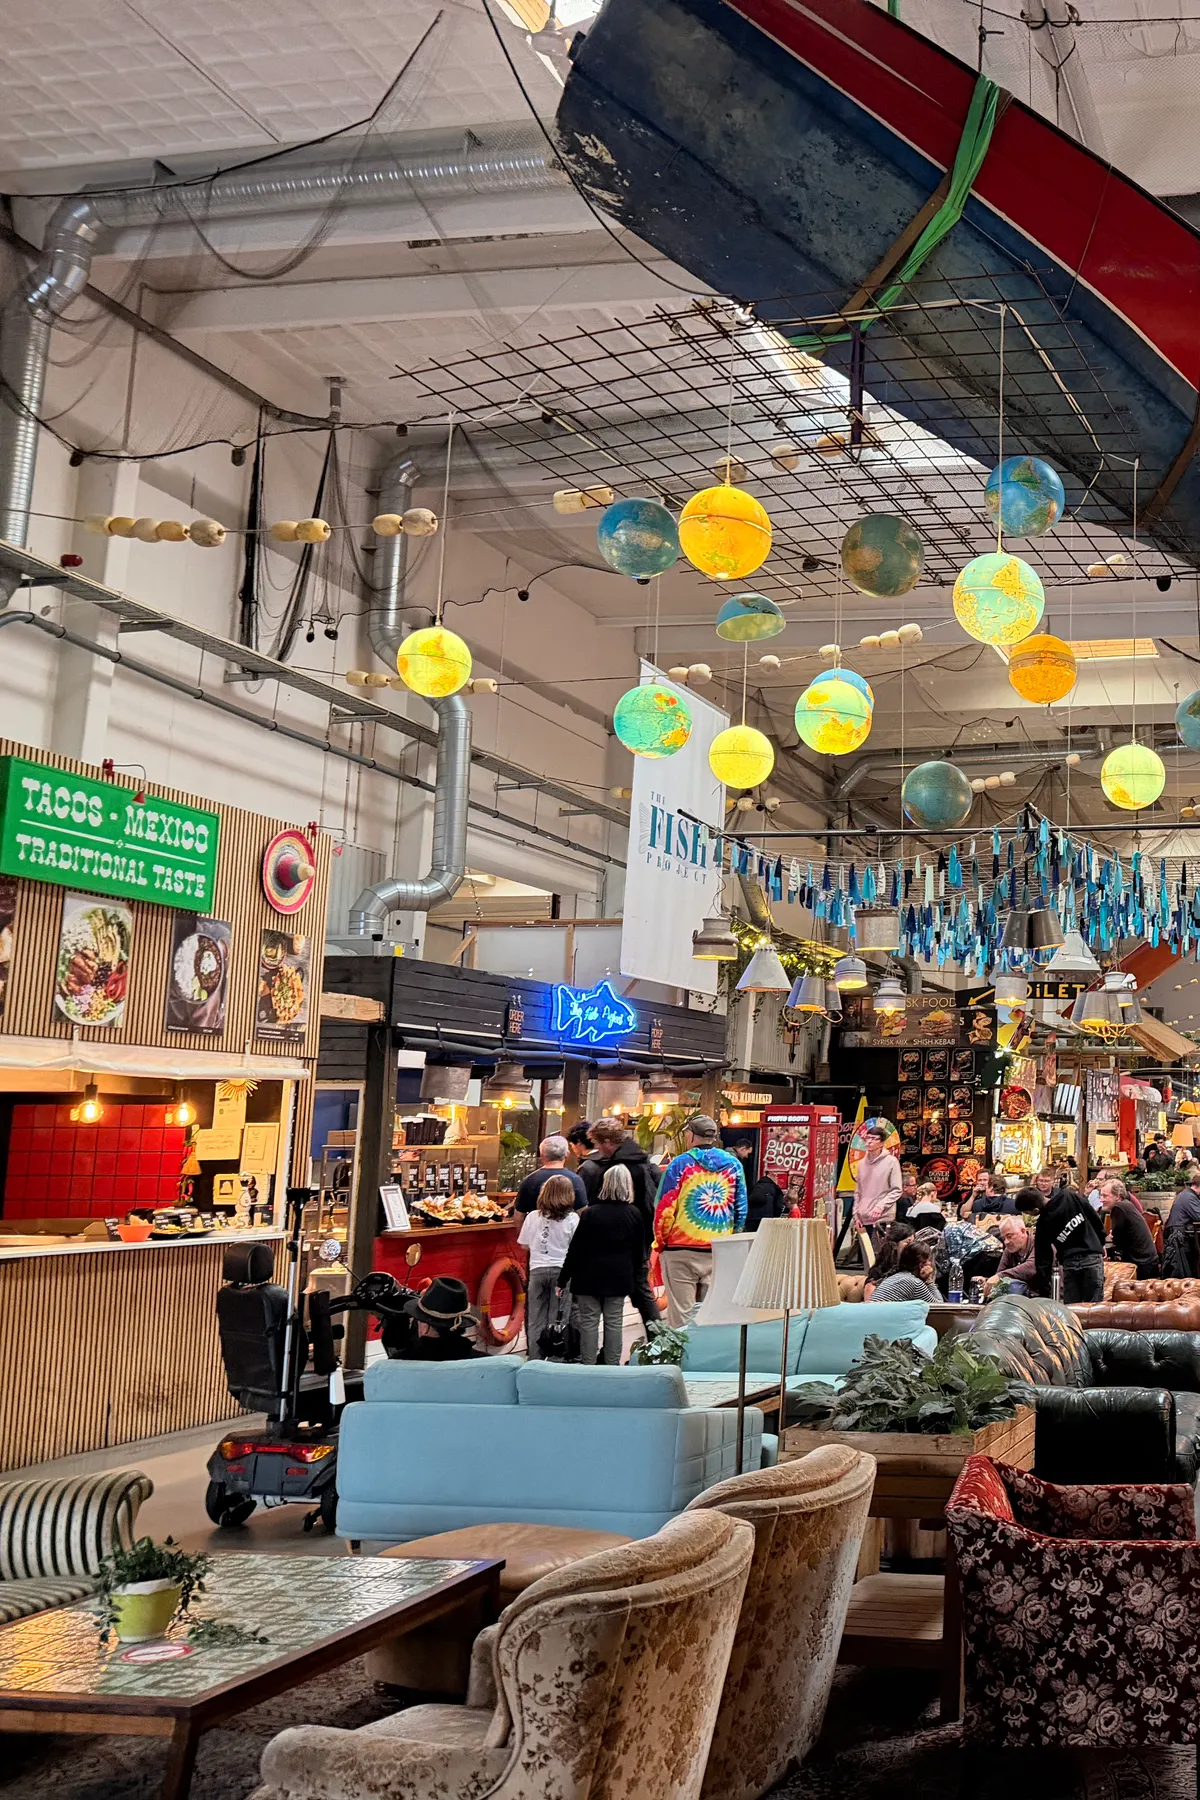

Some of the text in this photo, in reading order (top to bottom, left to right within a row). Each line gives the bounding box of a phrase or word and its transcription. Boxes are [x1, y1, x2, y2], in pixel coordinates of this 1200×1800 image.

[651, 791, 666, 805] THE
[21, 776, 103, 827] TACOS
[123, 805, 209, 854] MEXICO
[648, 804, 707, 869] FISH
[15, 833, 206, 898] TRADITIONAL TASTE
[646, 852, 707, 885] PROJECT
[1026, 983, 1085, 998] iLET
[922, 997, 957, 1008] FOOD
[873, 1038, 894, 1046] SYRISK
[766, 1140, 809, 1159] PHOTO
[763, 1149, 810, 1175] BOOTH
